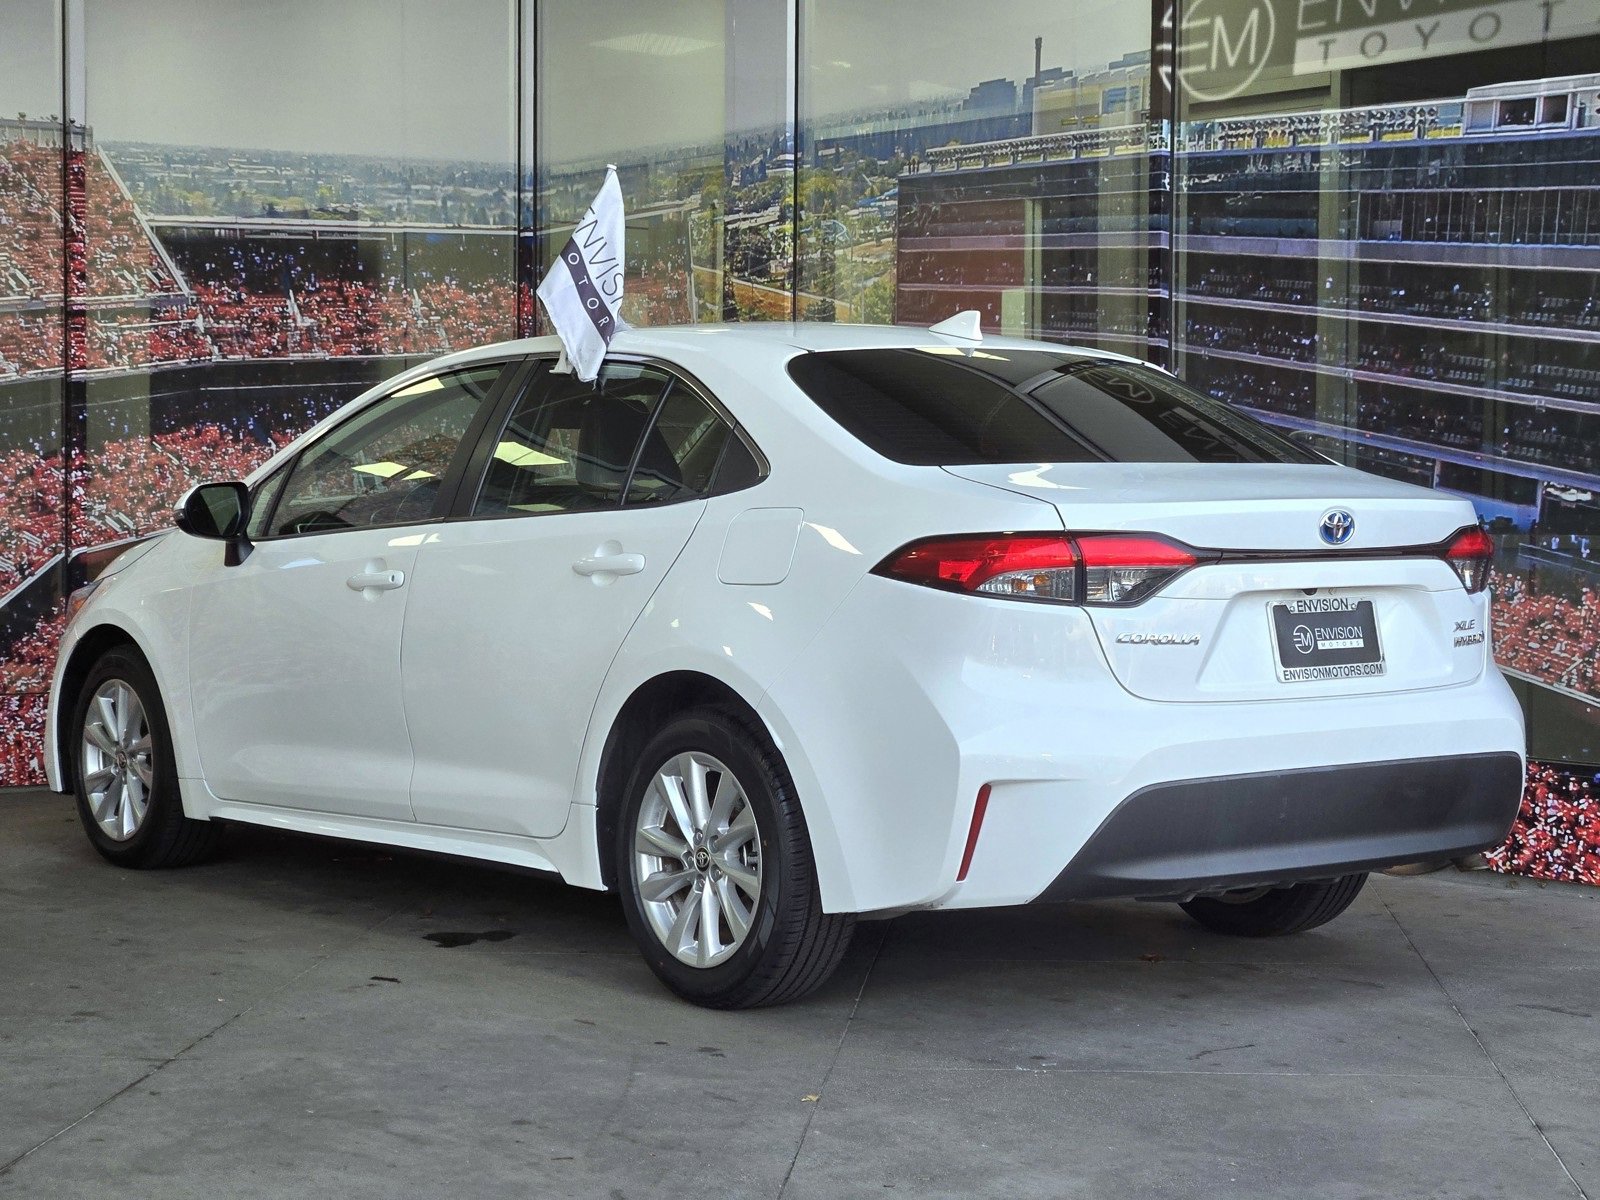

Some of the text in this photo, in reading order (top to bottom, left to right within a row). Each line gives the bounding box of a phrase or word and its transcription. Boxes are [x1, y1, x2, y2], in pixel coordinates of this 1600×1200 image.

[1318, 2, 1600, 65] TOYOT
[575, 207, 624, 305] NVIS
[567, 252, 611, 343] OTOR
[1296, 598, 1349, 612] ENVISION
[1315, 626, 1363, 640] ENVISION
[1453, 619, 1476, 632] XLE
[1115, 632, 1201, 646] COROLLA
[1283, 664, 1383, 681] ENVISIONMOTORS.COM
